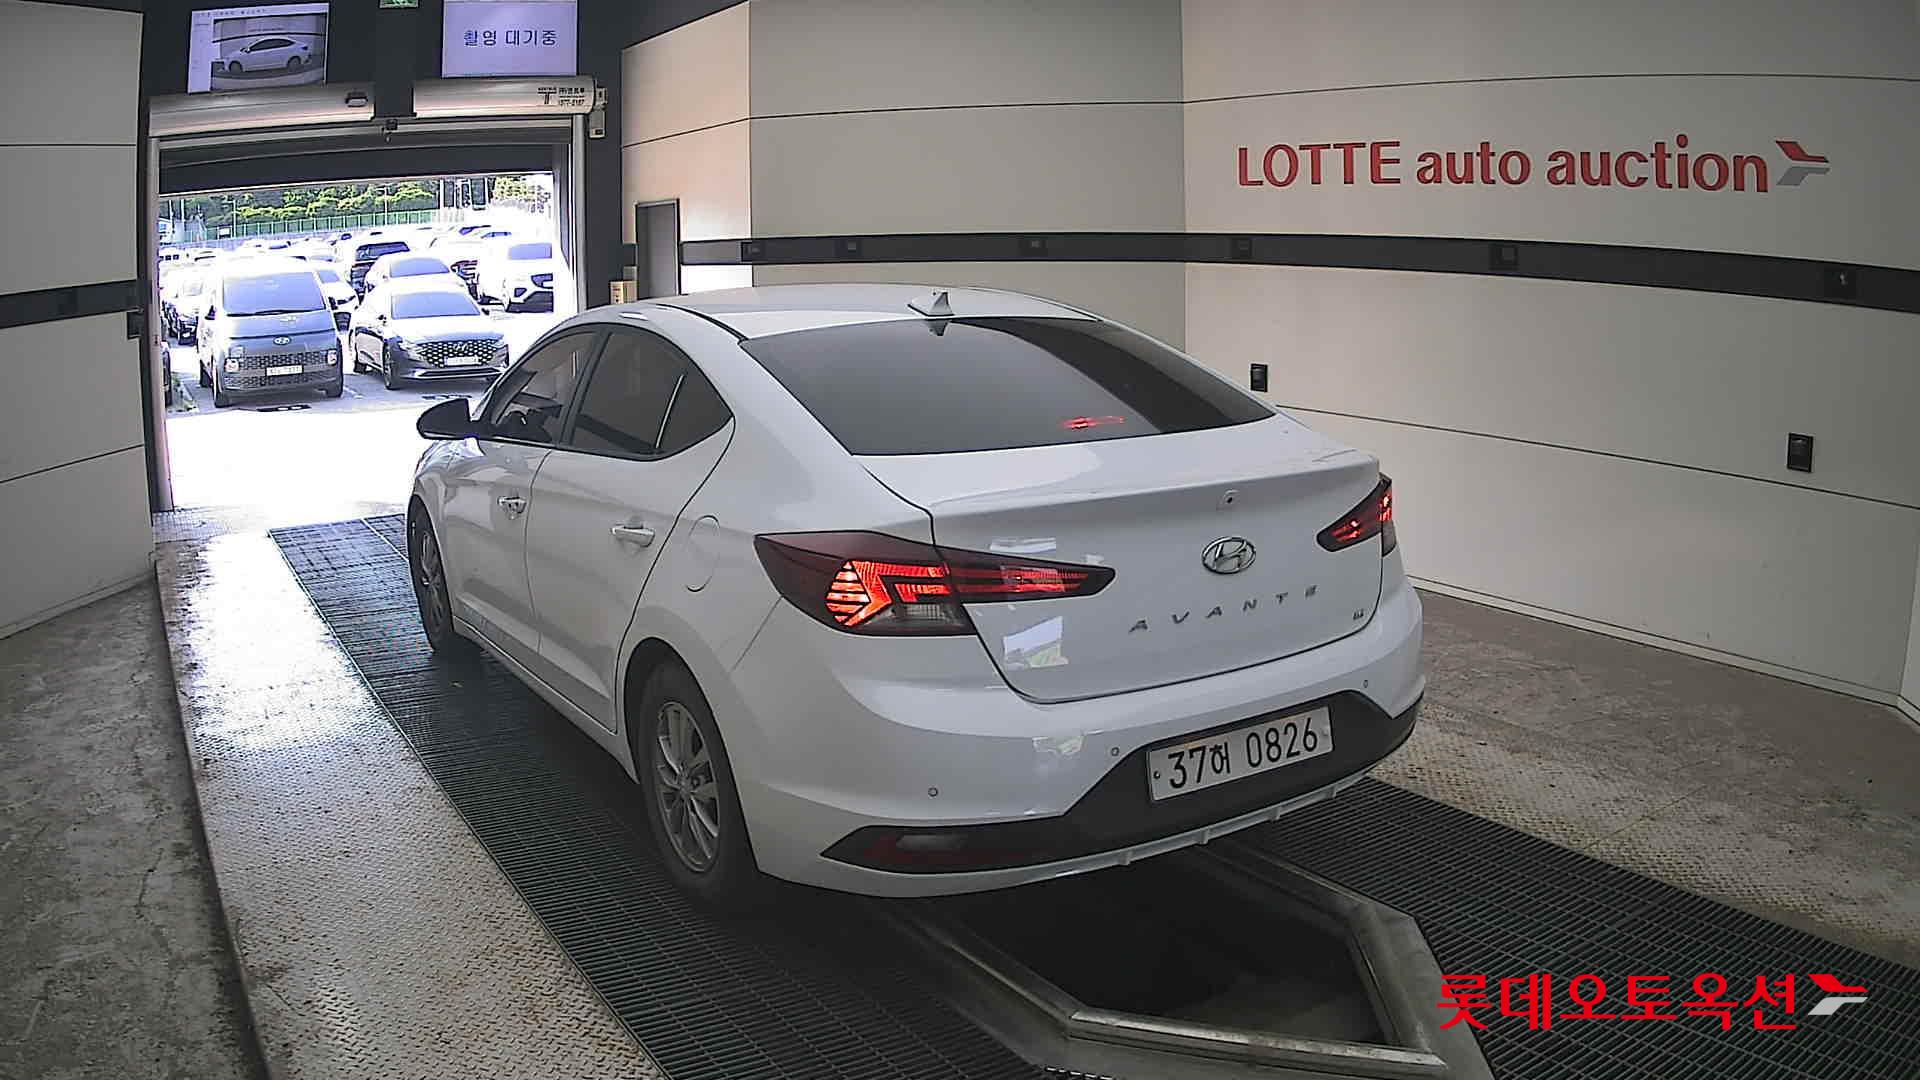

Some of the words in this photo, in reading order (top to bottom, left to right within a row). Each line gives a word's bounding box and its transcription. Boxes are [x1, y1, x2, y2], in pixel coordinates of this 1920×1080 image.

[505, 29, 557, 47] 대기중
[1237, 141, 1400, 188] LOTTE
[1416, 142, 1531, 185] auto
[1547, 134, 1769, 193] auction
[1128, 585, 1318, 633] AVANTE
[1167, 741, 1231, 789] 37허
[1245, 717, 1318, 768] 0826
